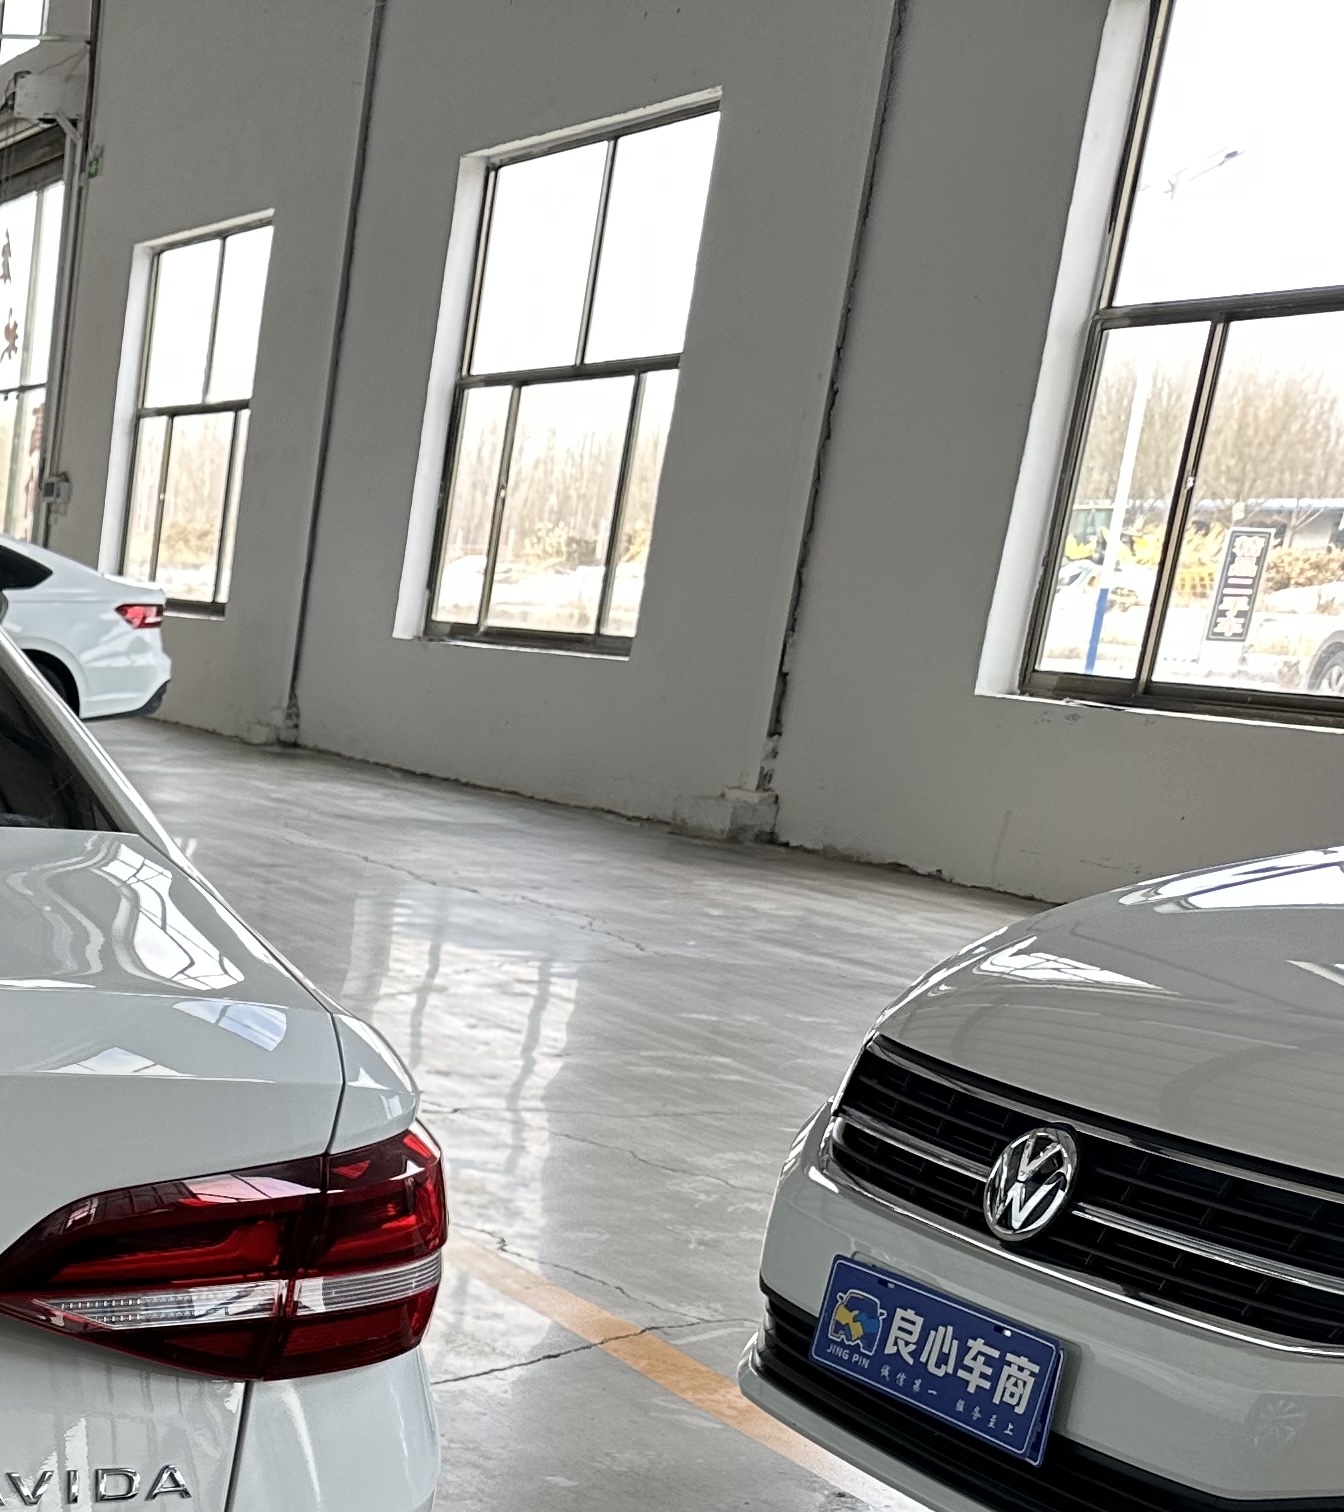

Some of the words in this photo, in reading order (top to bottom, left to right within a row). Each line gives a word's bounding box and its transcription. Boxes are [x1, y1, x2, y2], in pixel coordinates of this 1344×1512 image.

[826, 1343, 850, 1362] JING
[852, 1352, 869, 1369] PIN
[884, 1307, 1041, 1415] 良心车商
